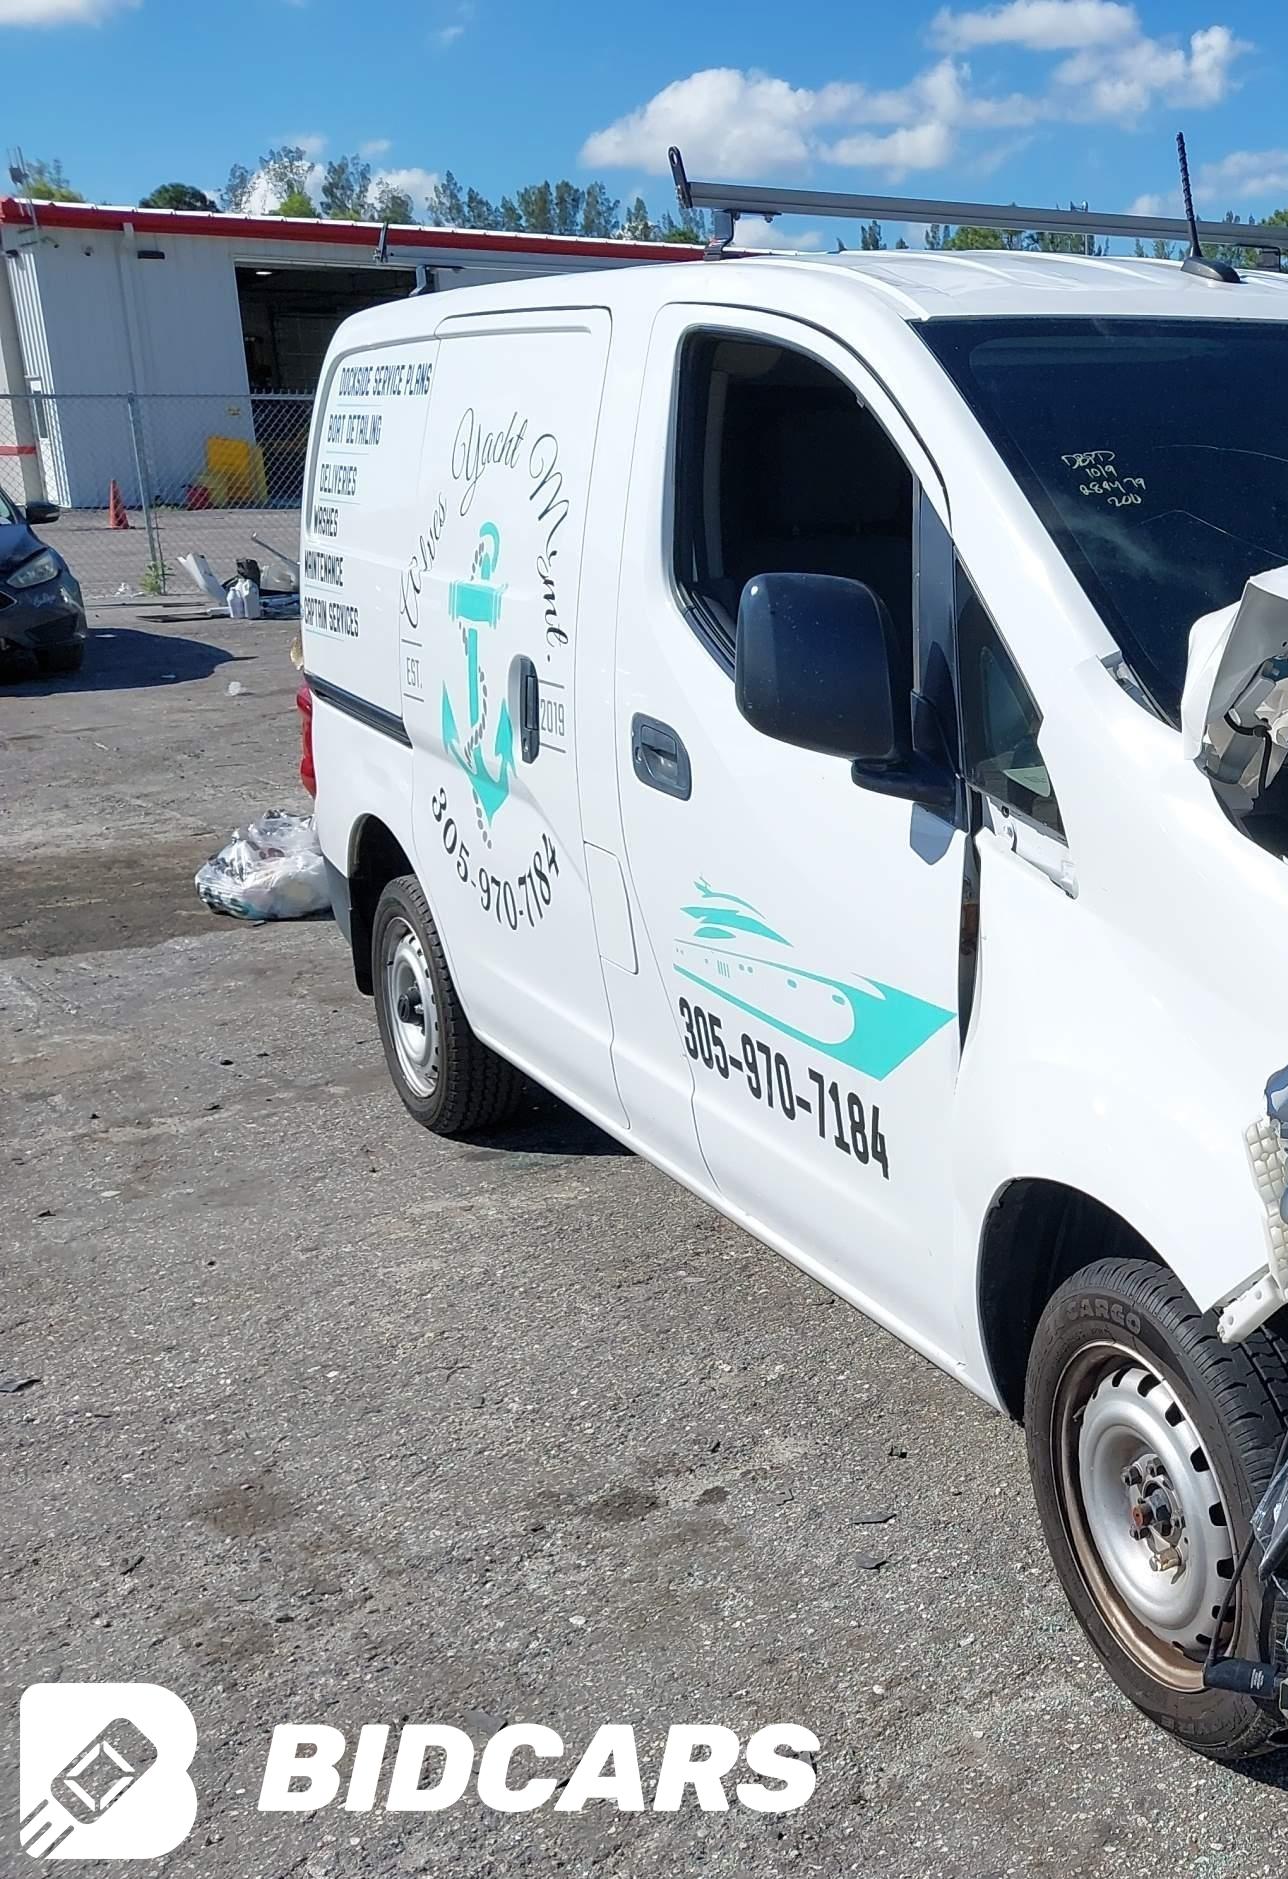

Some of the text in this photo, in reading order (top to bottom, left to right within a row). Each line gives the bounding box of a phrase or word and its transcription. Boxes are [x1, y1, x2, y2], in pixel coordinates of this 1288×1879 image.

[339, 362, 432, 396] DOCKSIDE SERVICE PLANS
[327, 413, 382, 445] BOAT DETAILING
[320, 463, 357, 496] DELIVERIES
[451, 408, 528, 516] Yacht
[314, 504, 338, 537] WASHES
[305, 549, 343, 587] MAINTENANCE
[304, 596, 359, 638] CAPTAIN SERVICES
[406, 656, 423, 689] EST.
[540, 698, 566, 737] 2019
[432, 787, 560, 930] 305-970-7184
[679, 996, 889, 1180] 305-970-7184
